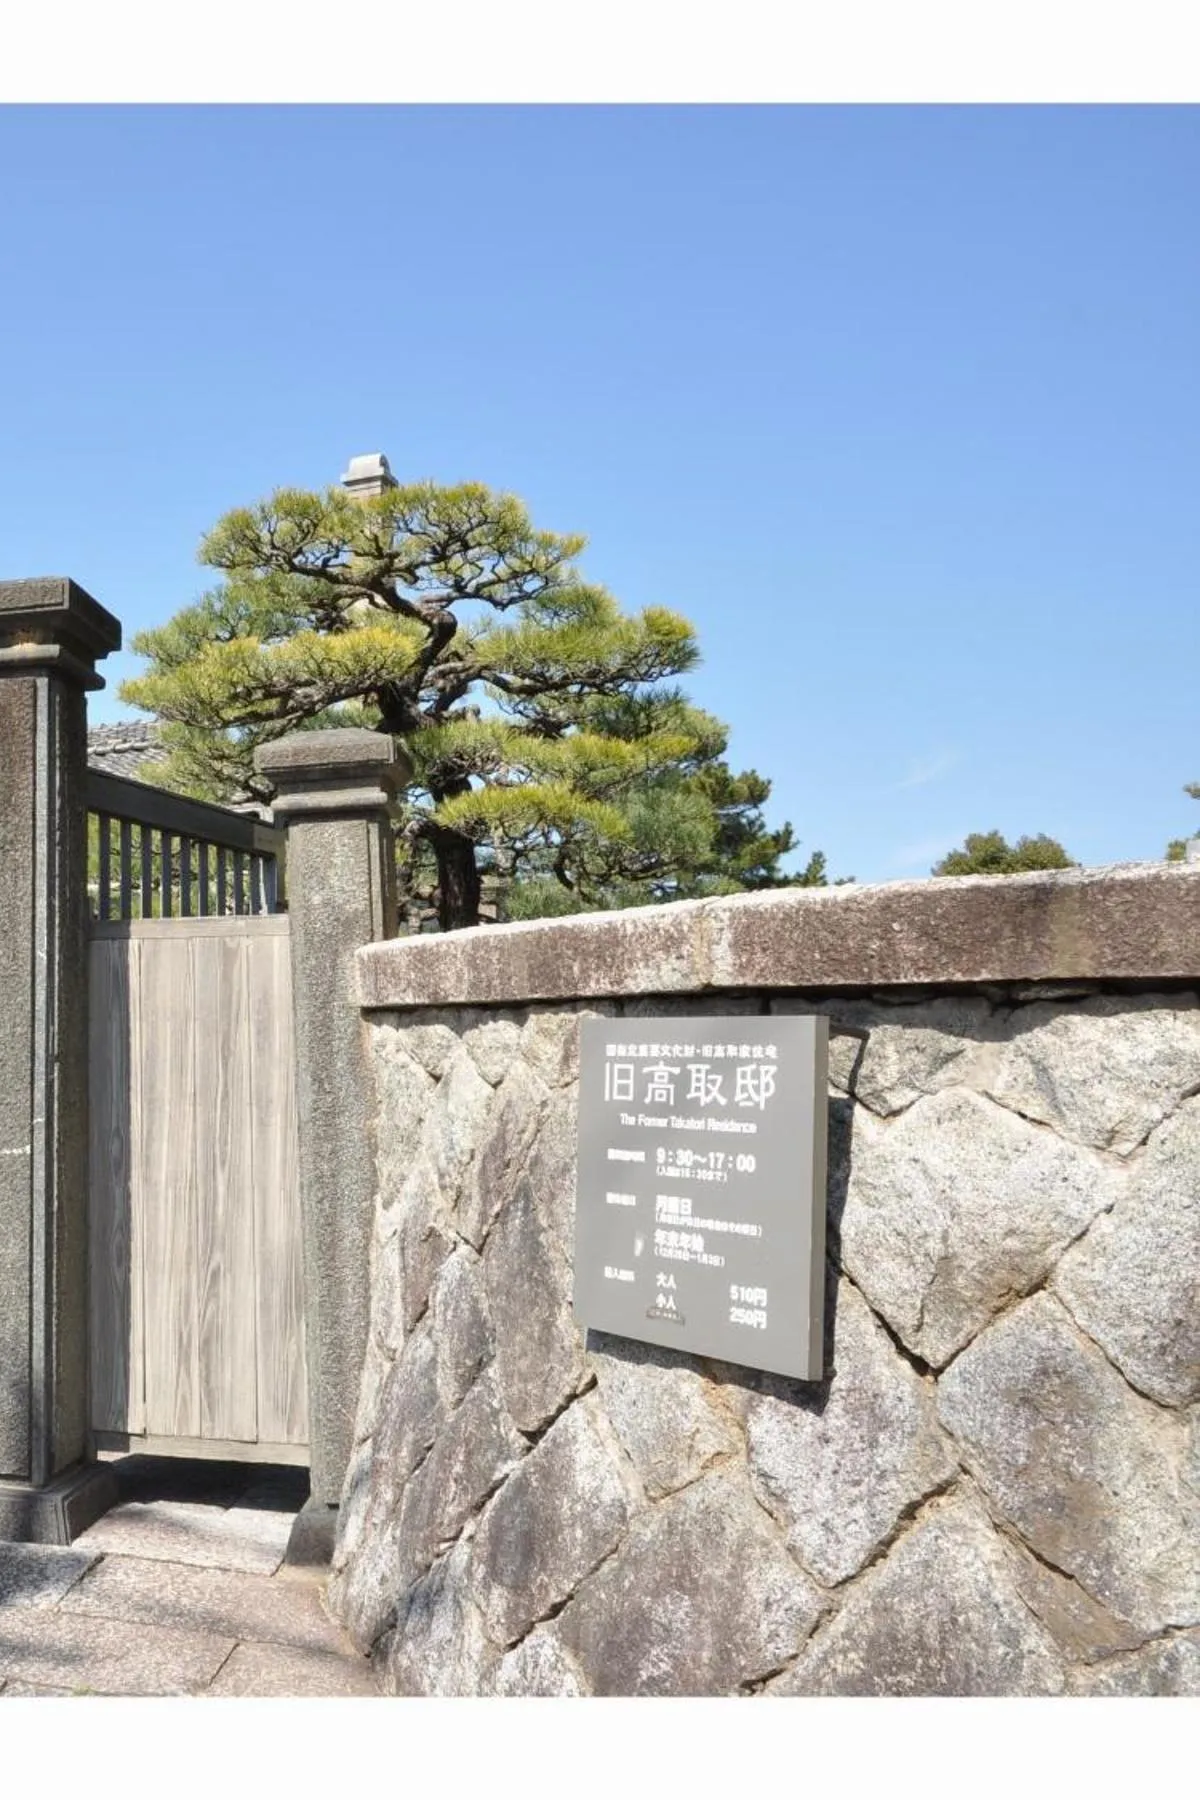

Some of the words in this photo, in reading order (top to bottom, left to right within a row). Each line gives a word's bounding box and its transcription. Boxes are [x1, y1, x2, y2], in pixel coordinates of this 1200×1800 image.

[604, 1060, 778, 1110] 旧高取邸
[620, 1112, 636, 1126] The
[638, 1113, 668, 1128] Former
[670, 1115, 706, 1131] Takatori
[707, 1117, 758, 1134] Residence
[655, 1194, 693, 1216] 月曜日
[654, 1228, 705, 1252] 年末年始
[655, 1271, 678, 1290] 大人
[655, 1292, 677, 1311] 小人
[729, 1284, 768, 1308] 510円
[729, 1306, 768, 1330] 250円
